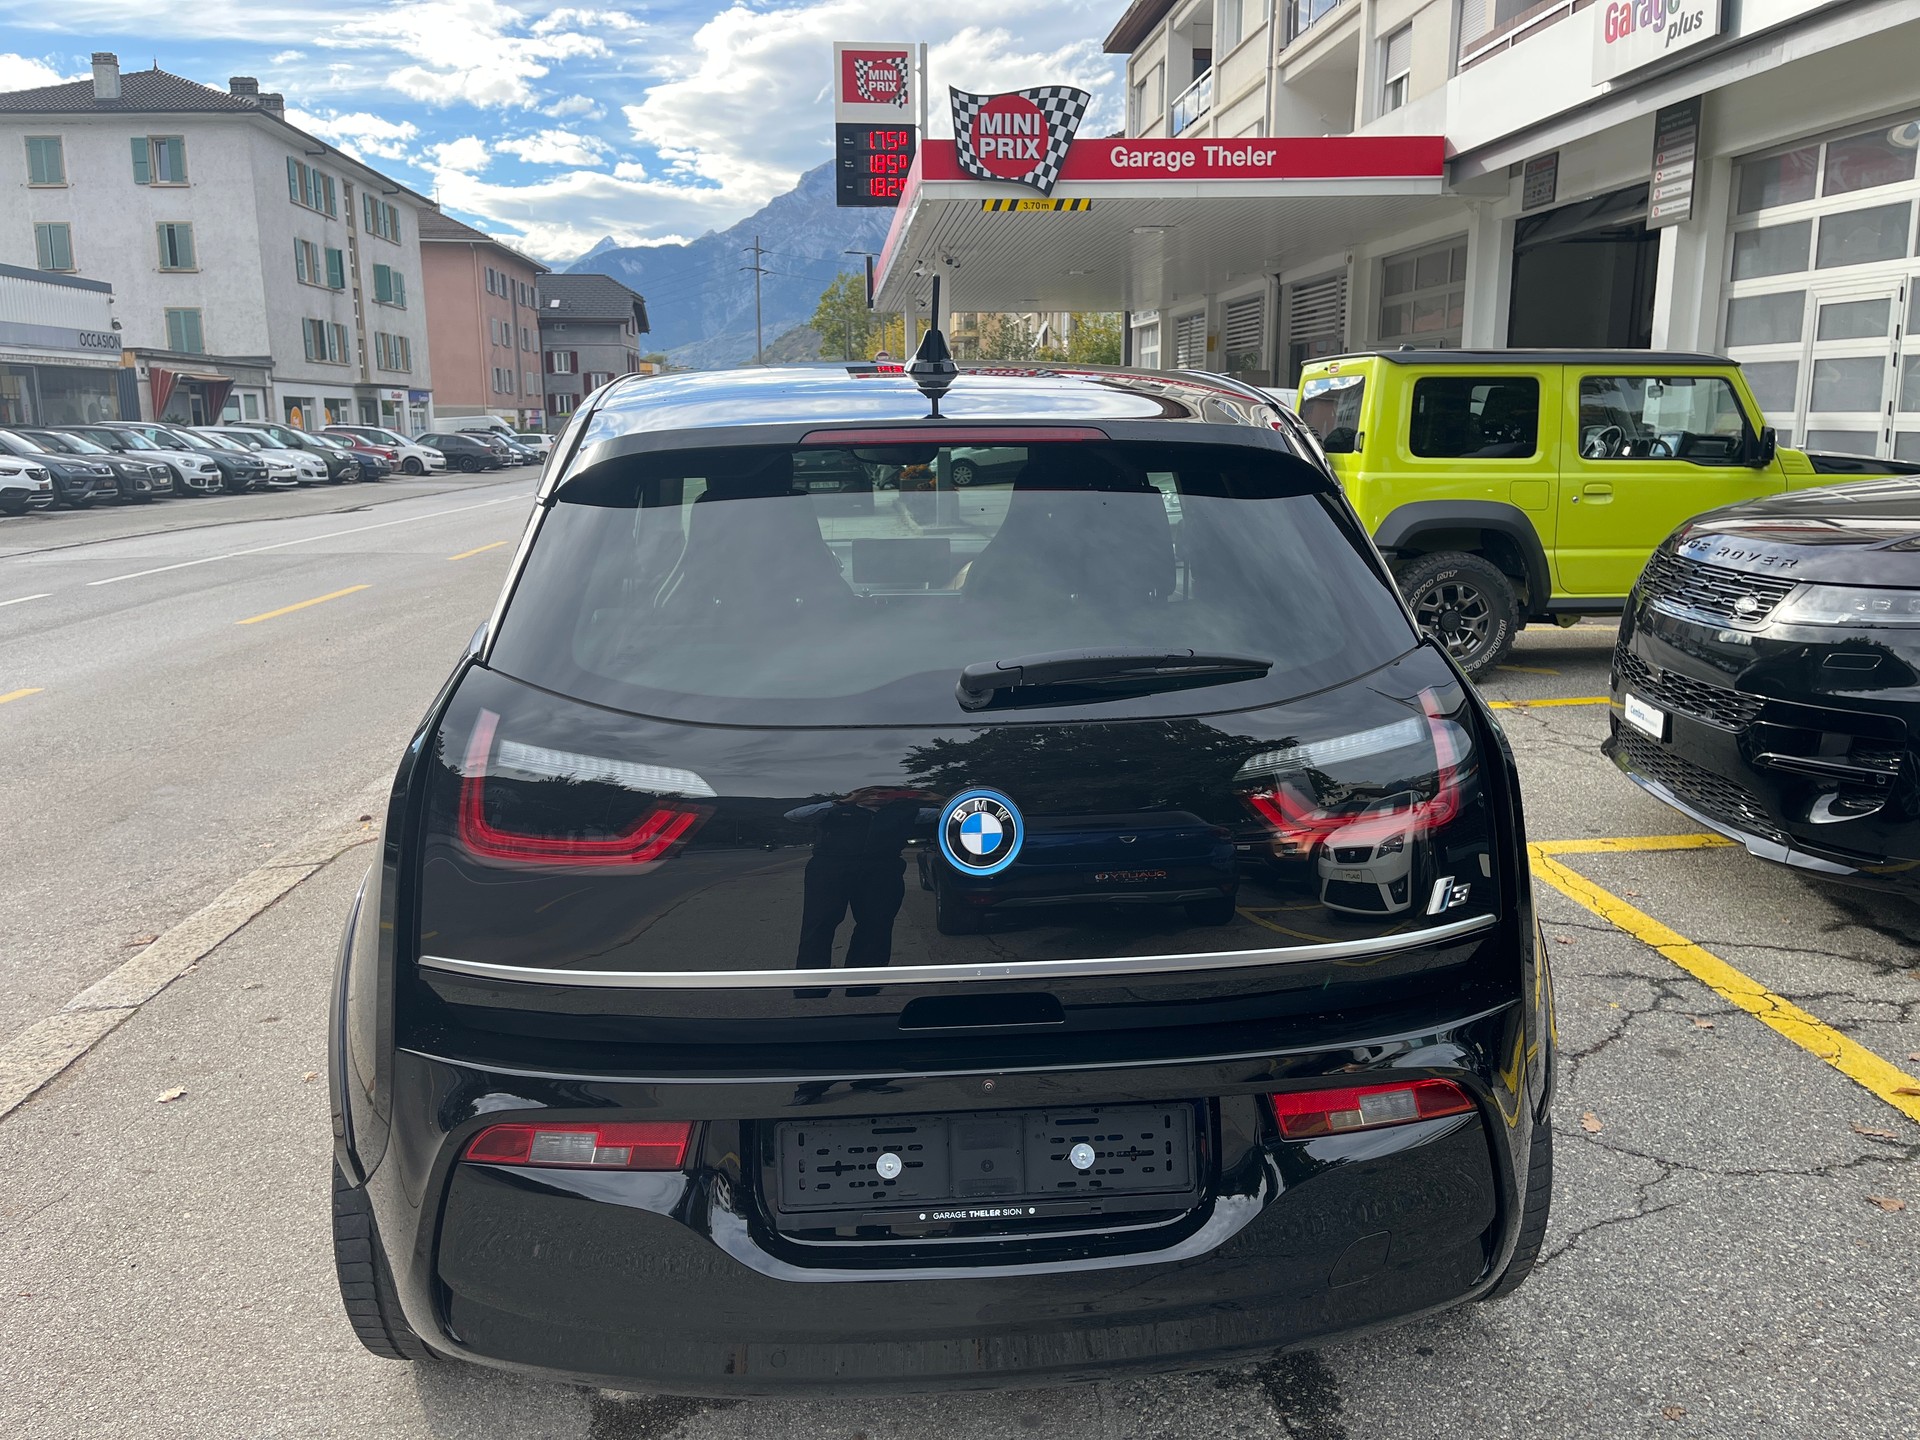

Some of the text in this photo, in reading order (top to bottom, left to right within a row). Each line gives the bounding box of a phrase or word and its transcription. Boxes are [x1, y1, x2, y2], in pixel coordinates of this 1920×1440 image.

[1664, 10, 1704, 48] plus
[868, 69, 897, 81] MINI
[868, 81, 898, 92] PRIX
[980, 112, 1040, 136] MINI
[980, 137, 1041, 159] PRIX
[1110, 145, 1277, 172] Garage Theler
[79, 332, 121, 350] OCCASION
[1715, 546, 1799, 569] ROVER
[953, 800, 1011, 822] BMW
[1426, 875, 1472, 915] i3
[932, 1207, 1022, 1220] GARAGE THELER SION
